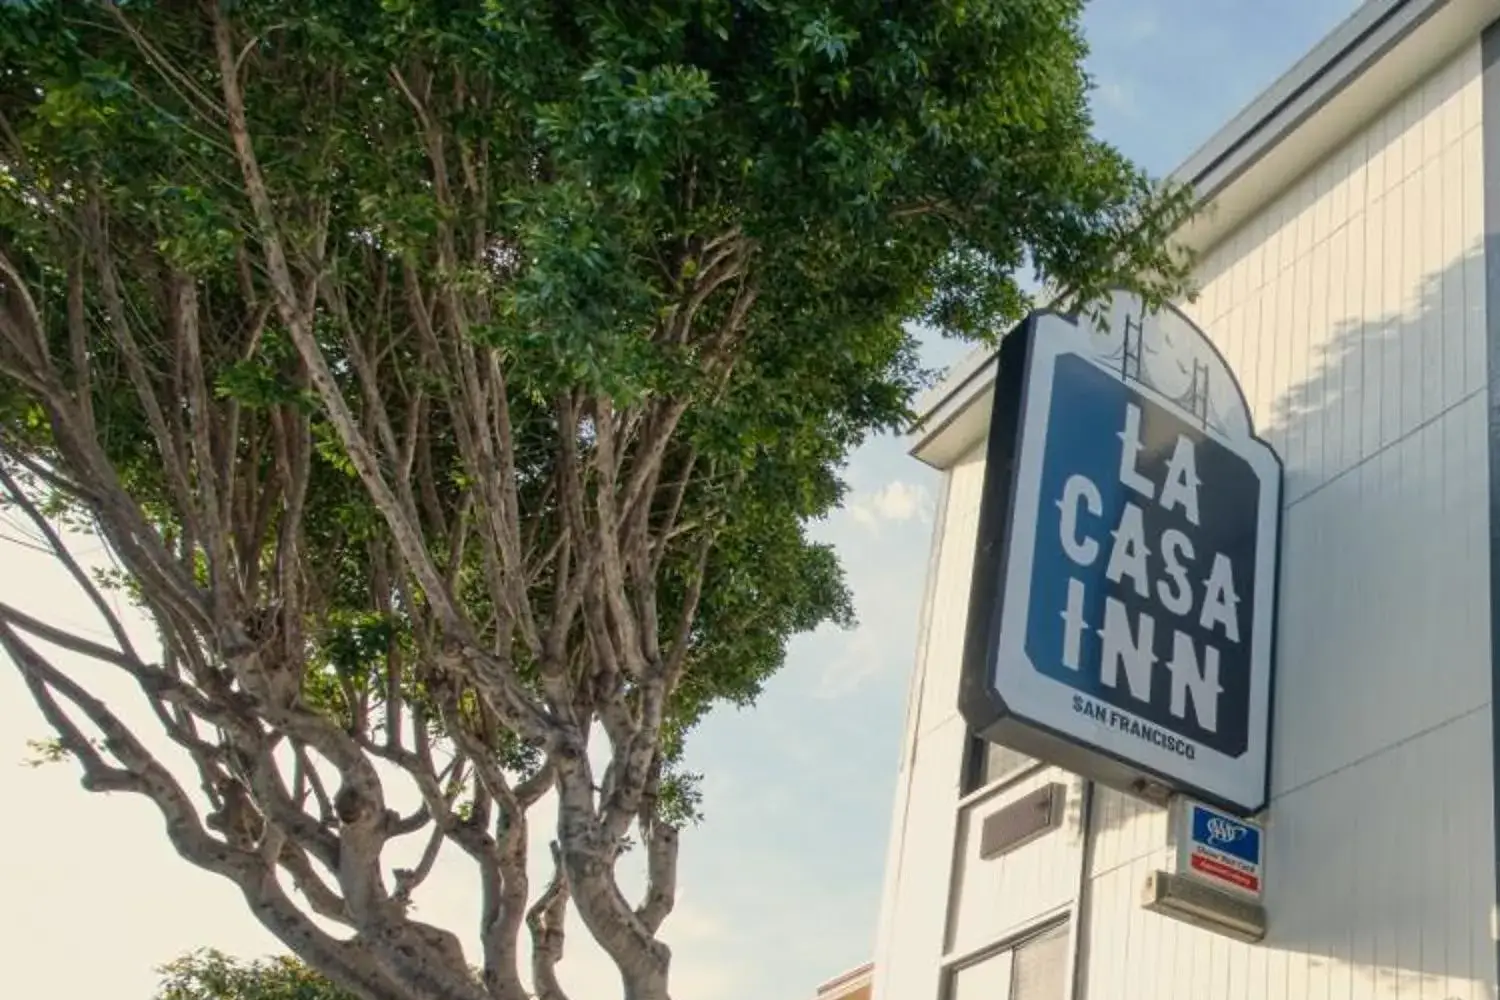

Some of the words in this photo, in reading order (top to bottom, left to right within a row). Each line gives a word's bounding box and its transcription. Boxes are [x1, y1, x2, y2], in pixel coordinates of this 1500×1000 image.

[1116, 402, 1202, 526] LA
[1055, 474, 1241, 644] CASA
[1060, 577, 1225, 733] INN
[1072, 693, 1107, 723] SAN
[1109, 710, 1196, 761] FRANCISCO
